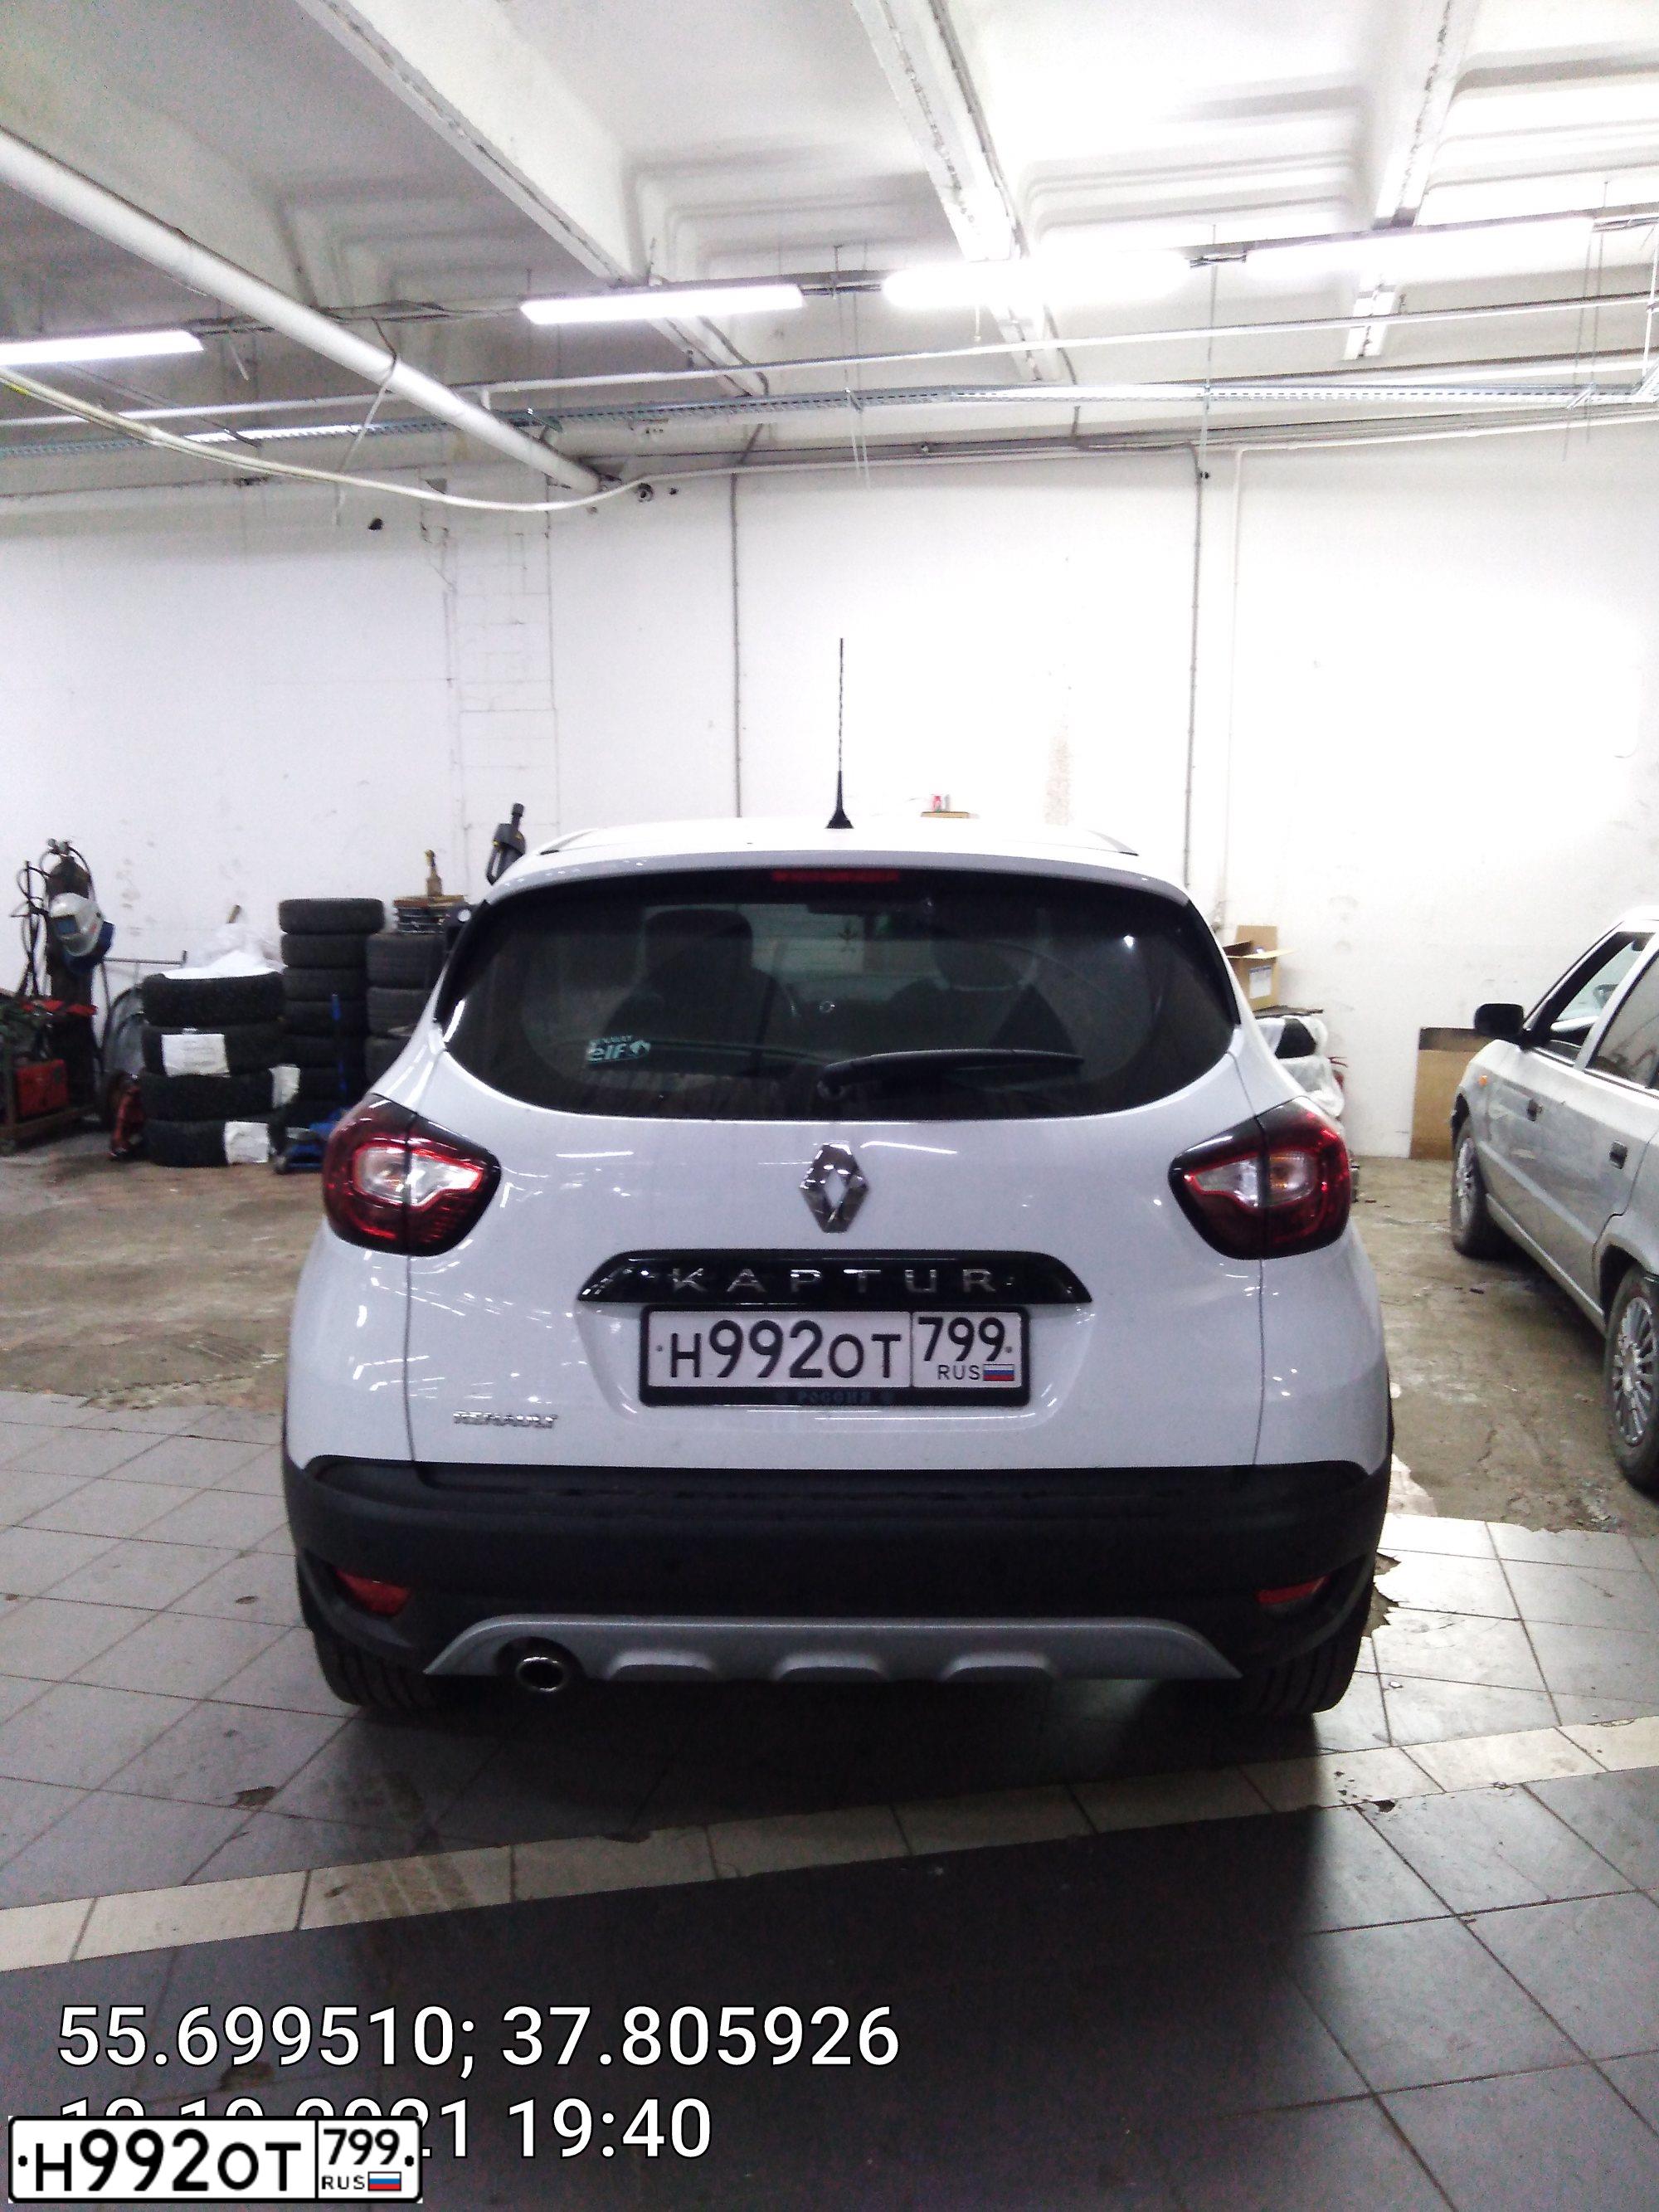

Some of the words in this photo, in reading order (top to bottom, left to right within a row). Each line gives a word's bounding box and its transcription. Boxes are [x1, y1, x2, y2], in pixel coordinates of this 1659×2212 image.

[670, 1268, 996, 1293] KAPTUR
[918, 1317, 1005, 1362] 799
[937, 1364, 980, 1381] RUS
